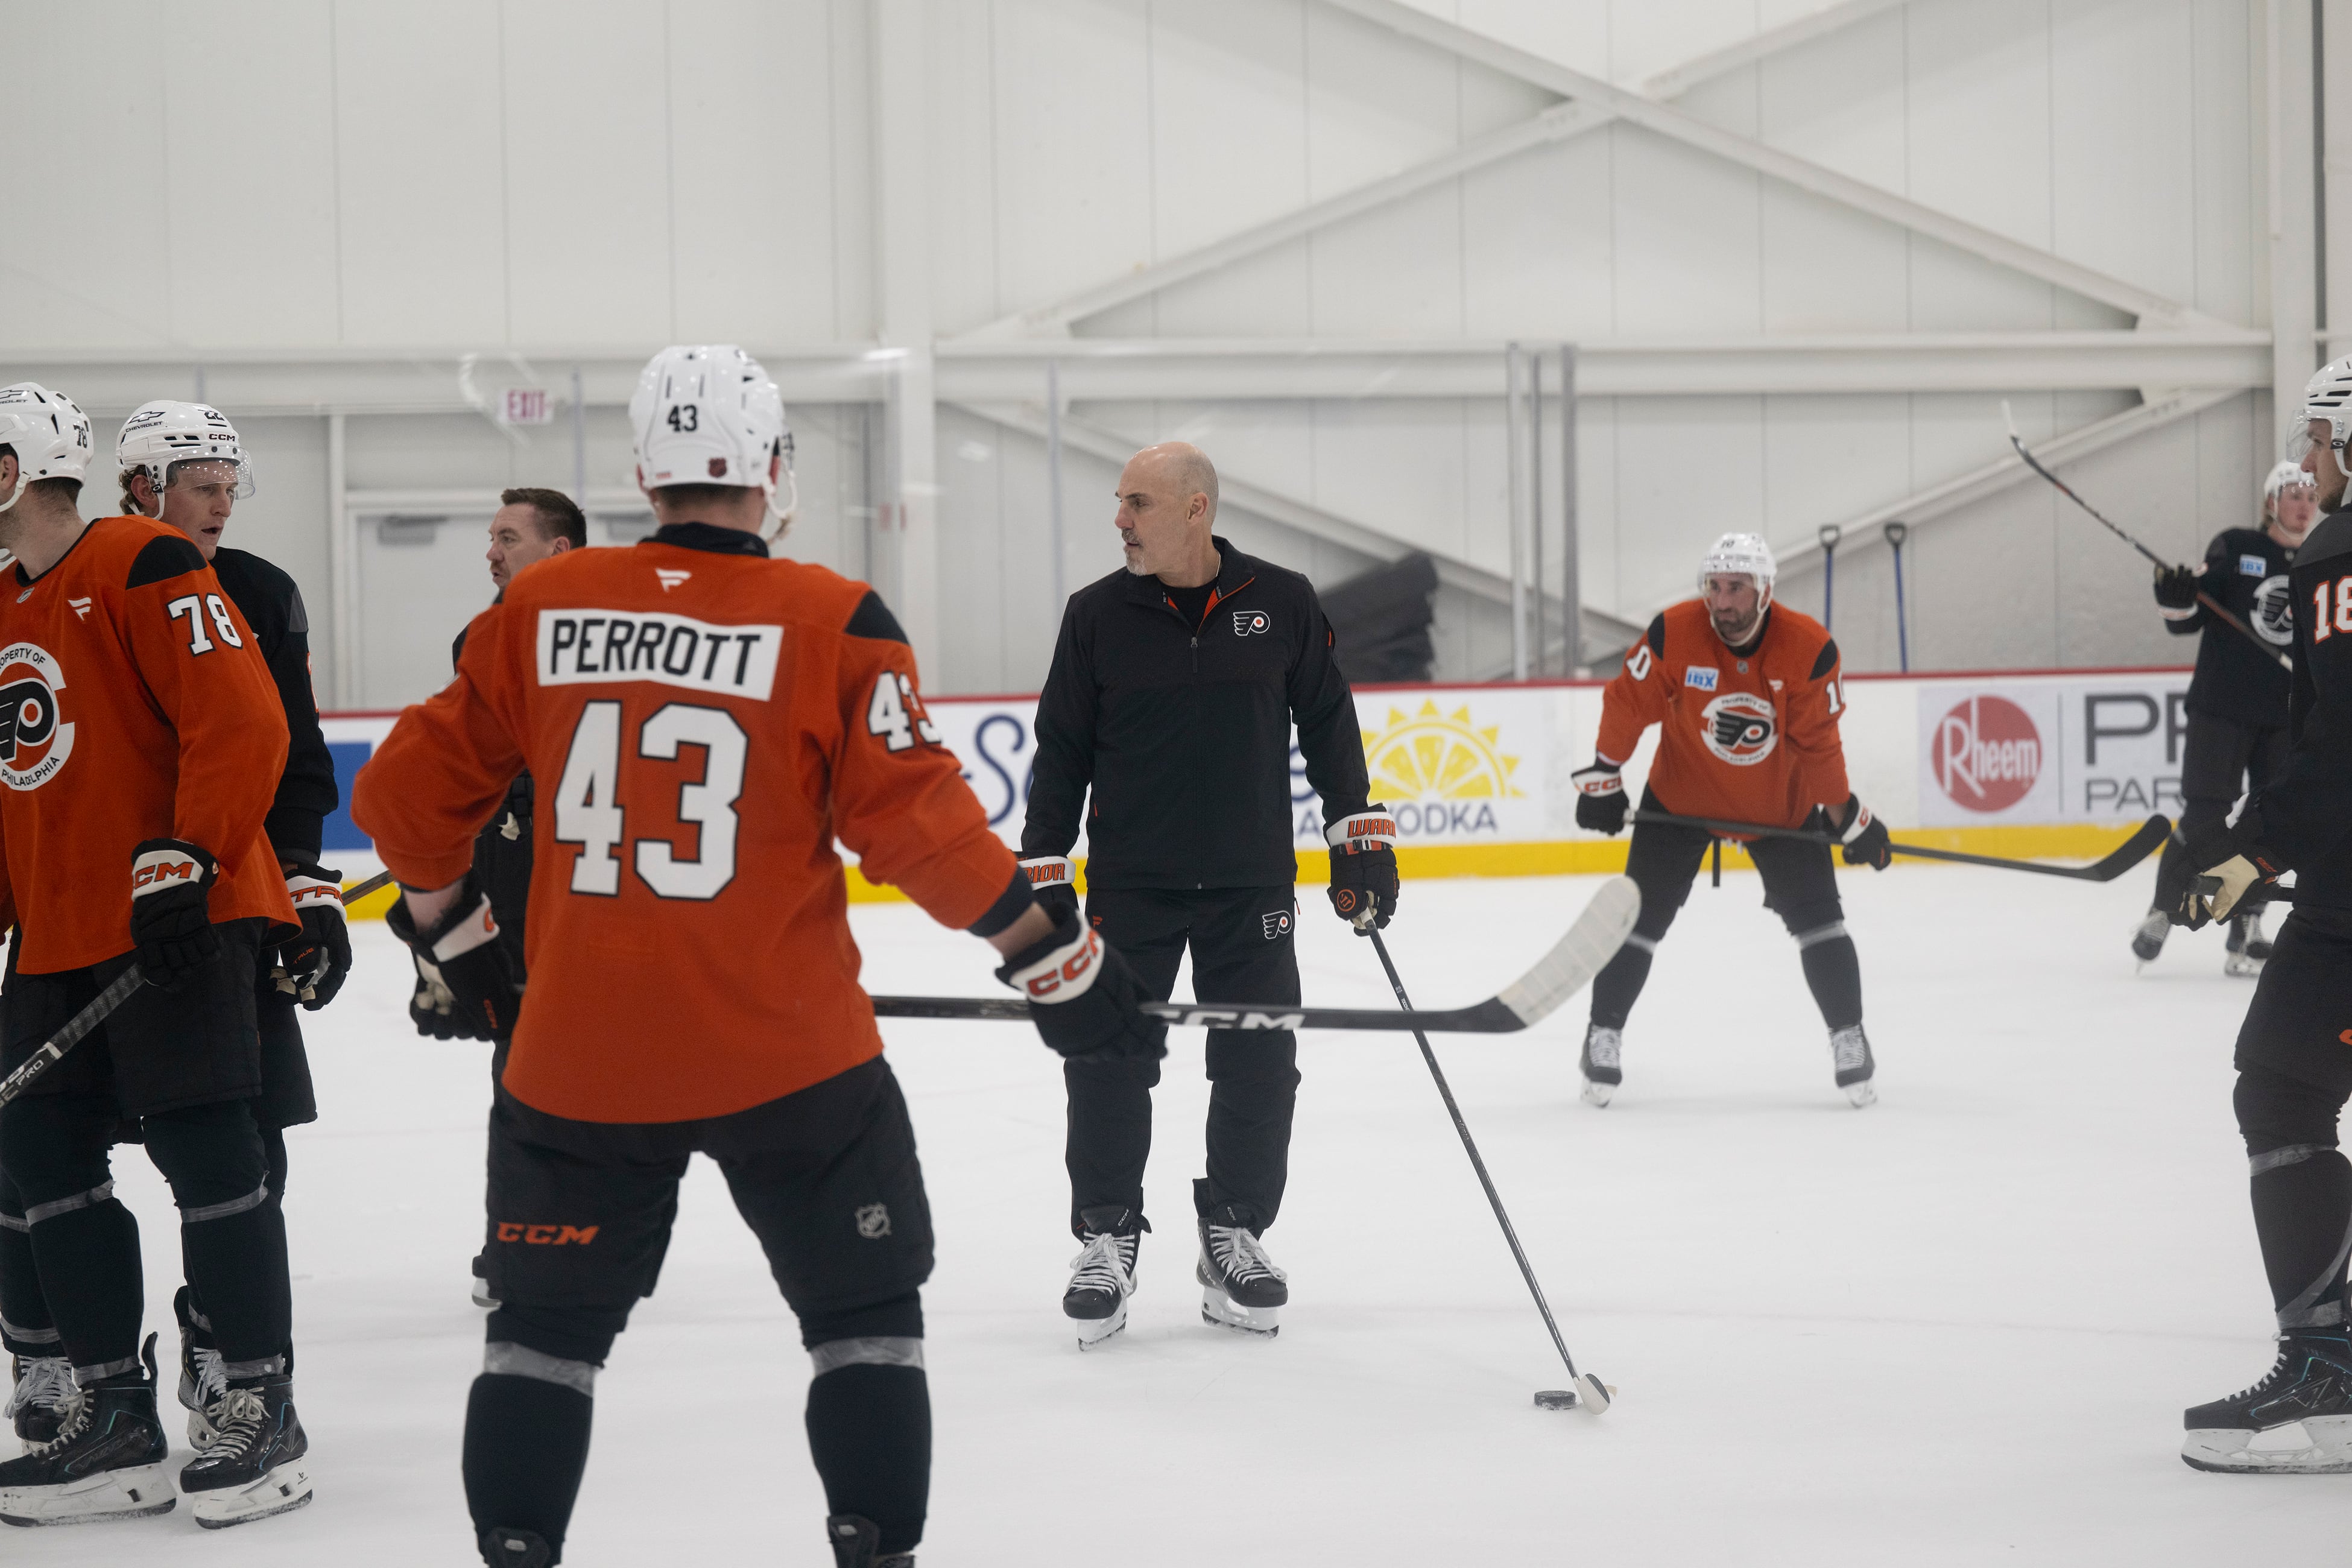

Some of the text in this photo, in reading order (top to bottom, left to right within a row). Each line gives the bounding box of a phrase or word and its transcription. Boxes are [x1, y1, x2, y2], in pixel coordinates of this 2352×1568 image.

[125, 421, 163, 432] CHEVROLET
[668, 405, 698, 432] 43
[73, 424, 87, 449] 78
[209, 433, 235, 441] CCM
[167, 592, 243, 657] 78
[0, 648, 46, 669] OPERTY OF
[551, 618, 761, 686] PERROTT
[1687, 672, 1716, 688] IBX
[1942, 695, 2037, 799] Rheem
[554, 700, 750, 901] 43
[2086, 776, 2186, 812] PAR
[134, 861, 194, 890] CM
[16, 1060, 44, 1086] PRO
[498, 1222, 599, 1245] CCM
